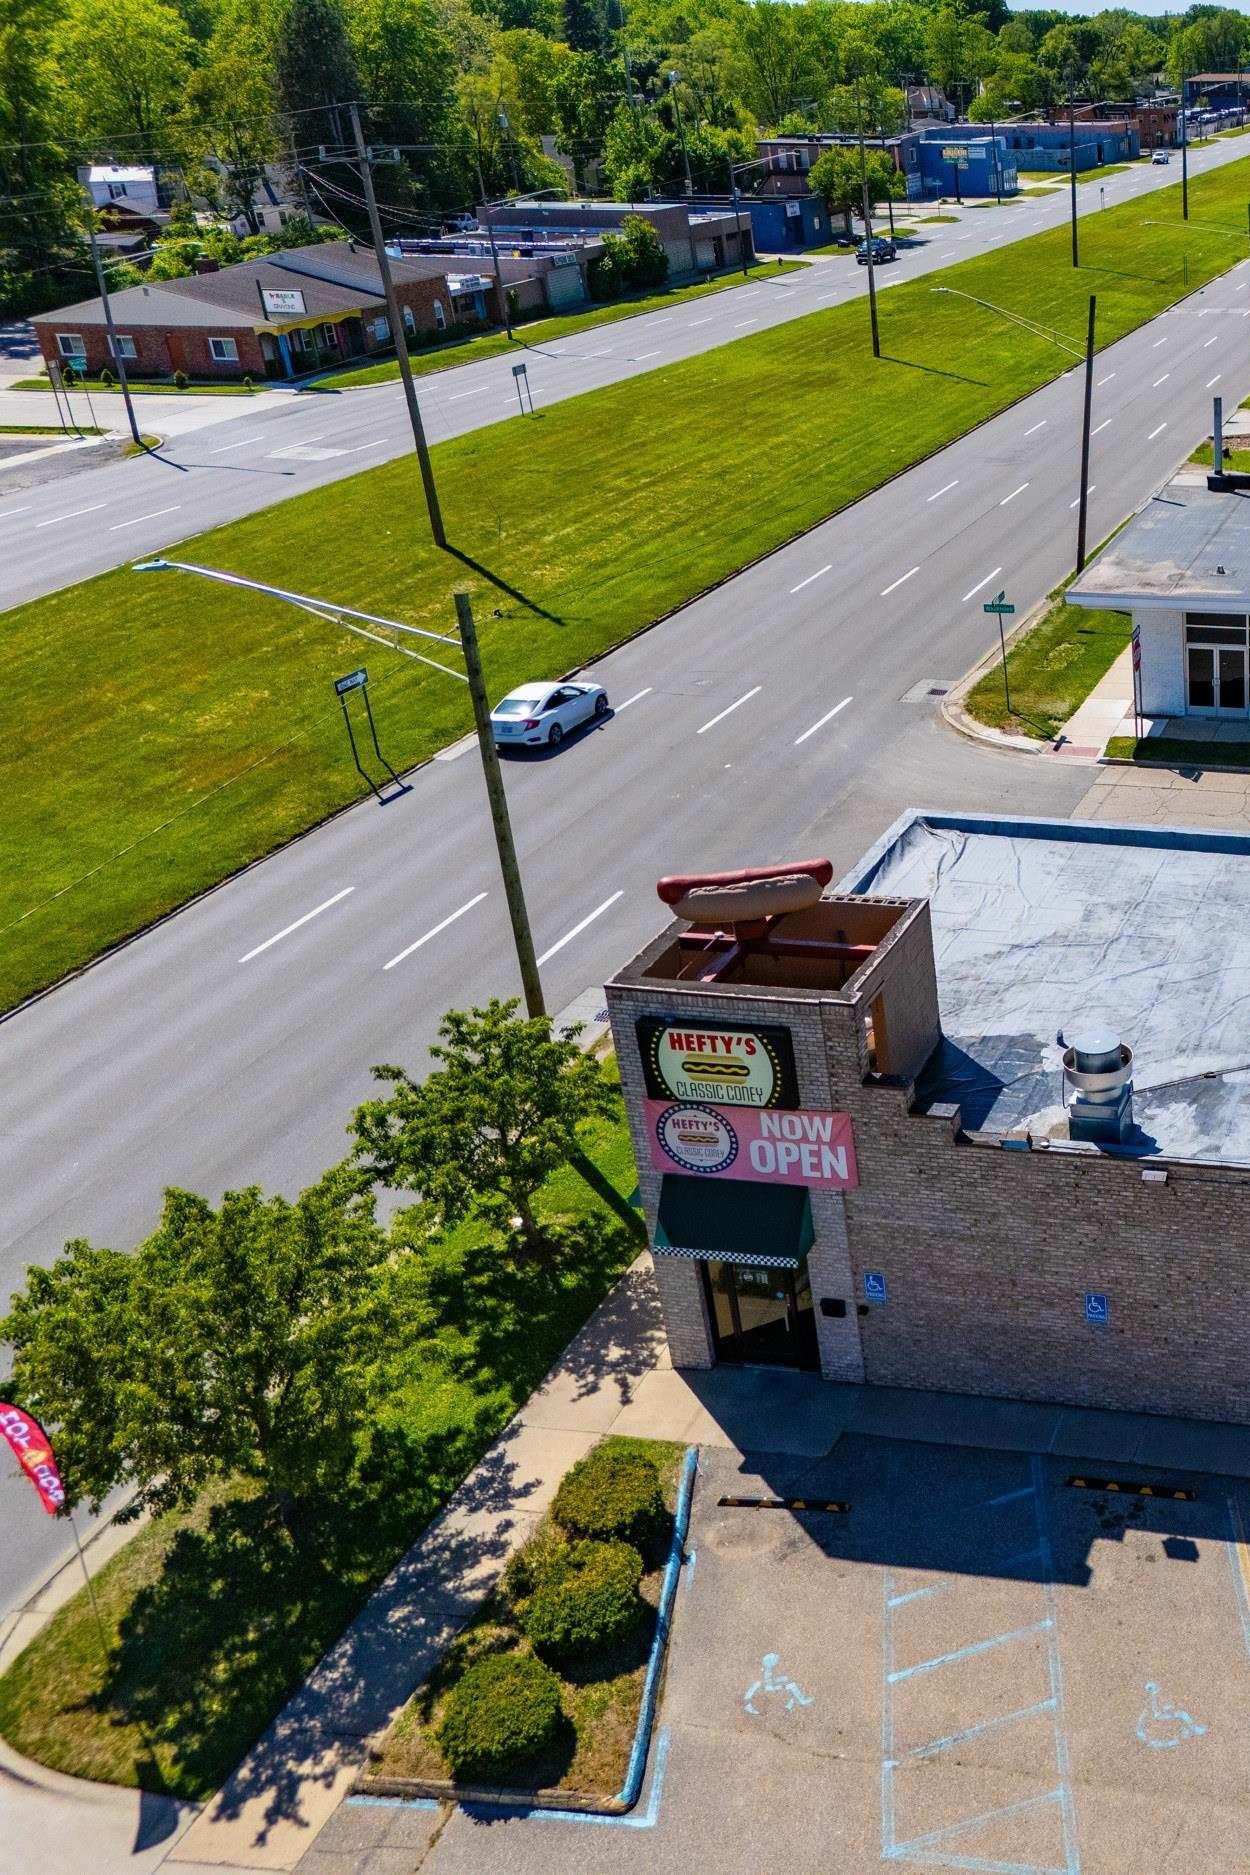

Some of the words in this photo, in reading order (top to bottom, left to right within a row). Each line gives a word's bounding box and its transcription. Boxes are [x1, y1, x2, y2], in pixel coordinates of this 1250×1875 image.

[668, 1032, 756, 1056] HEFTY'S
[676, 1081, 724, 1100] CLASSIC
[726, 1085, 763, 1102] CONEY
[671, 1118, 720, 1132] HEFTY'S
[759, 1111, 833, 1143] NOW
[750, 1139, 849, 1180] OPEN
